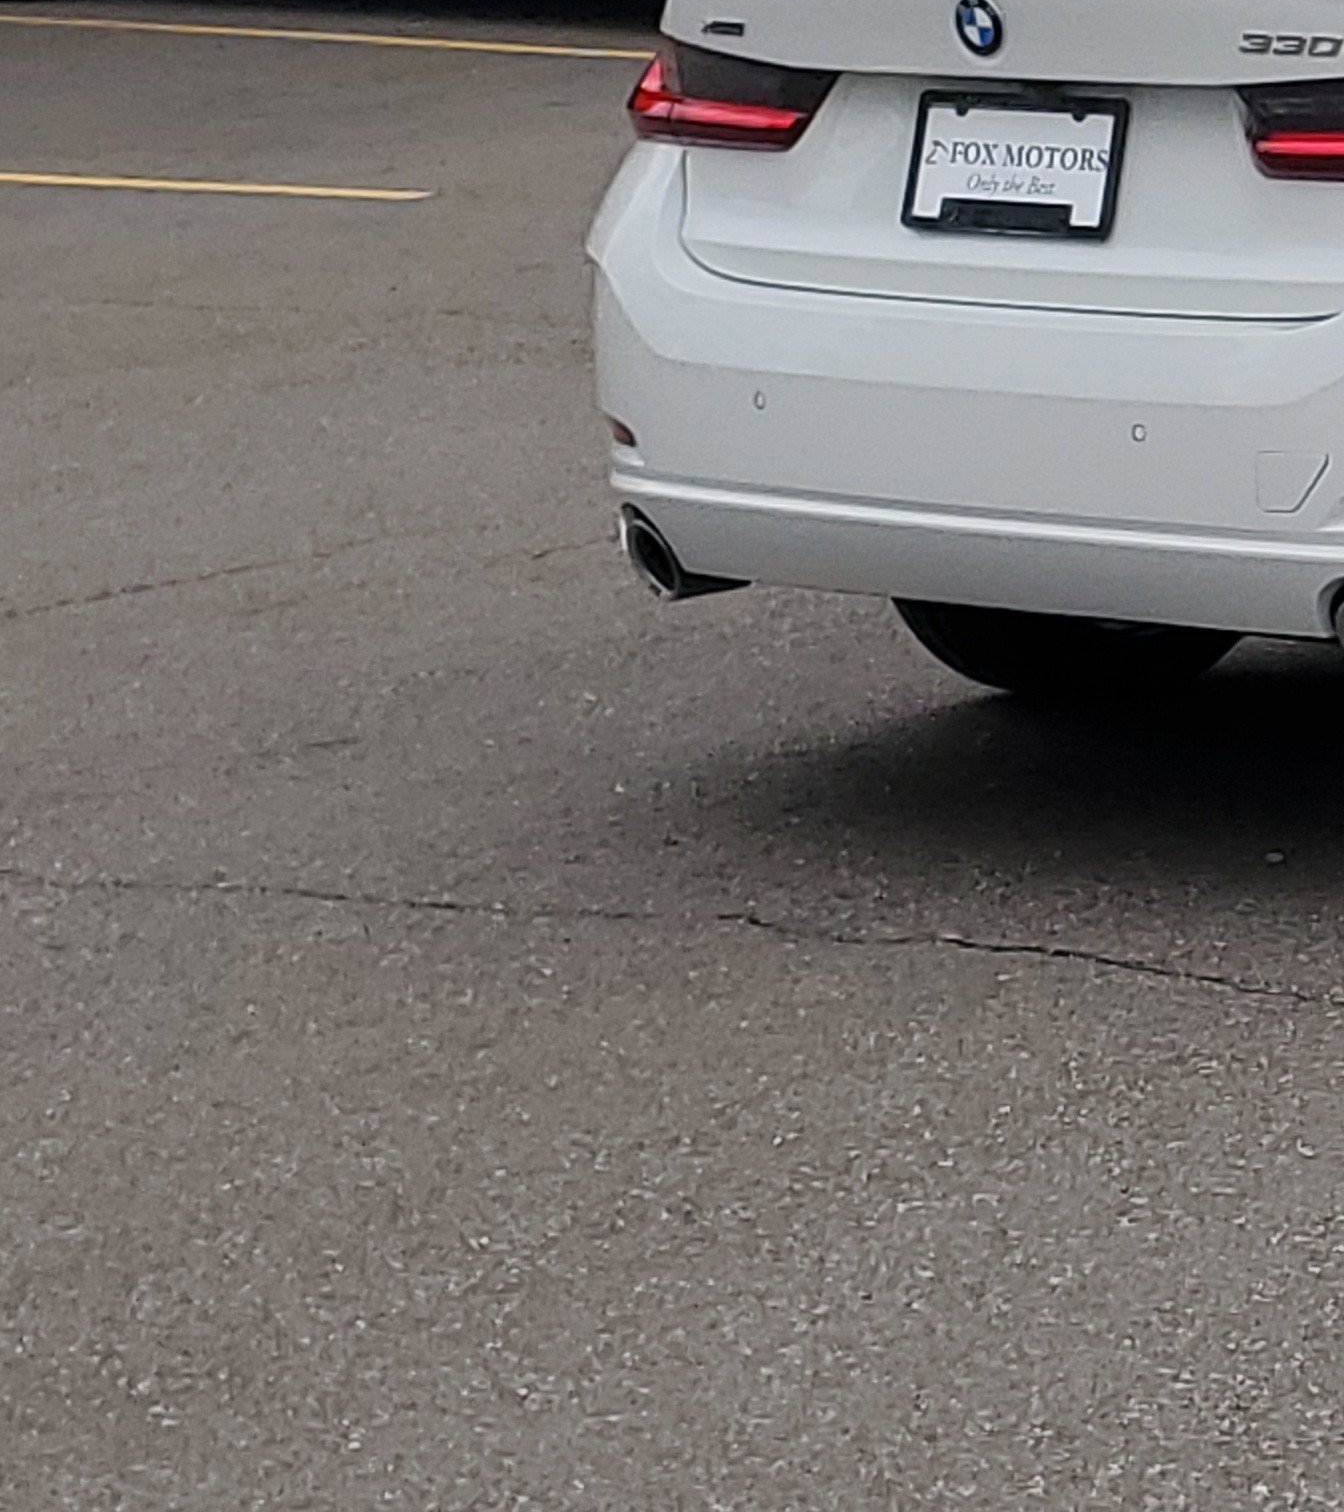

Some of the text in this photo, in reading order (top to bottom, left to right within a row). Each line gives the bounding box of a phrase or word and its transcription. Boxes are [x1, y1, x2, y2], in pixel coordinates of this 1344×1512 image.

[950, 141, 1109, 172] FOX MOTORS
[966, 173, 1001, 195] Only
[1027, 175, 1055, 196] Best
